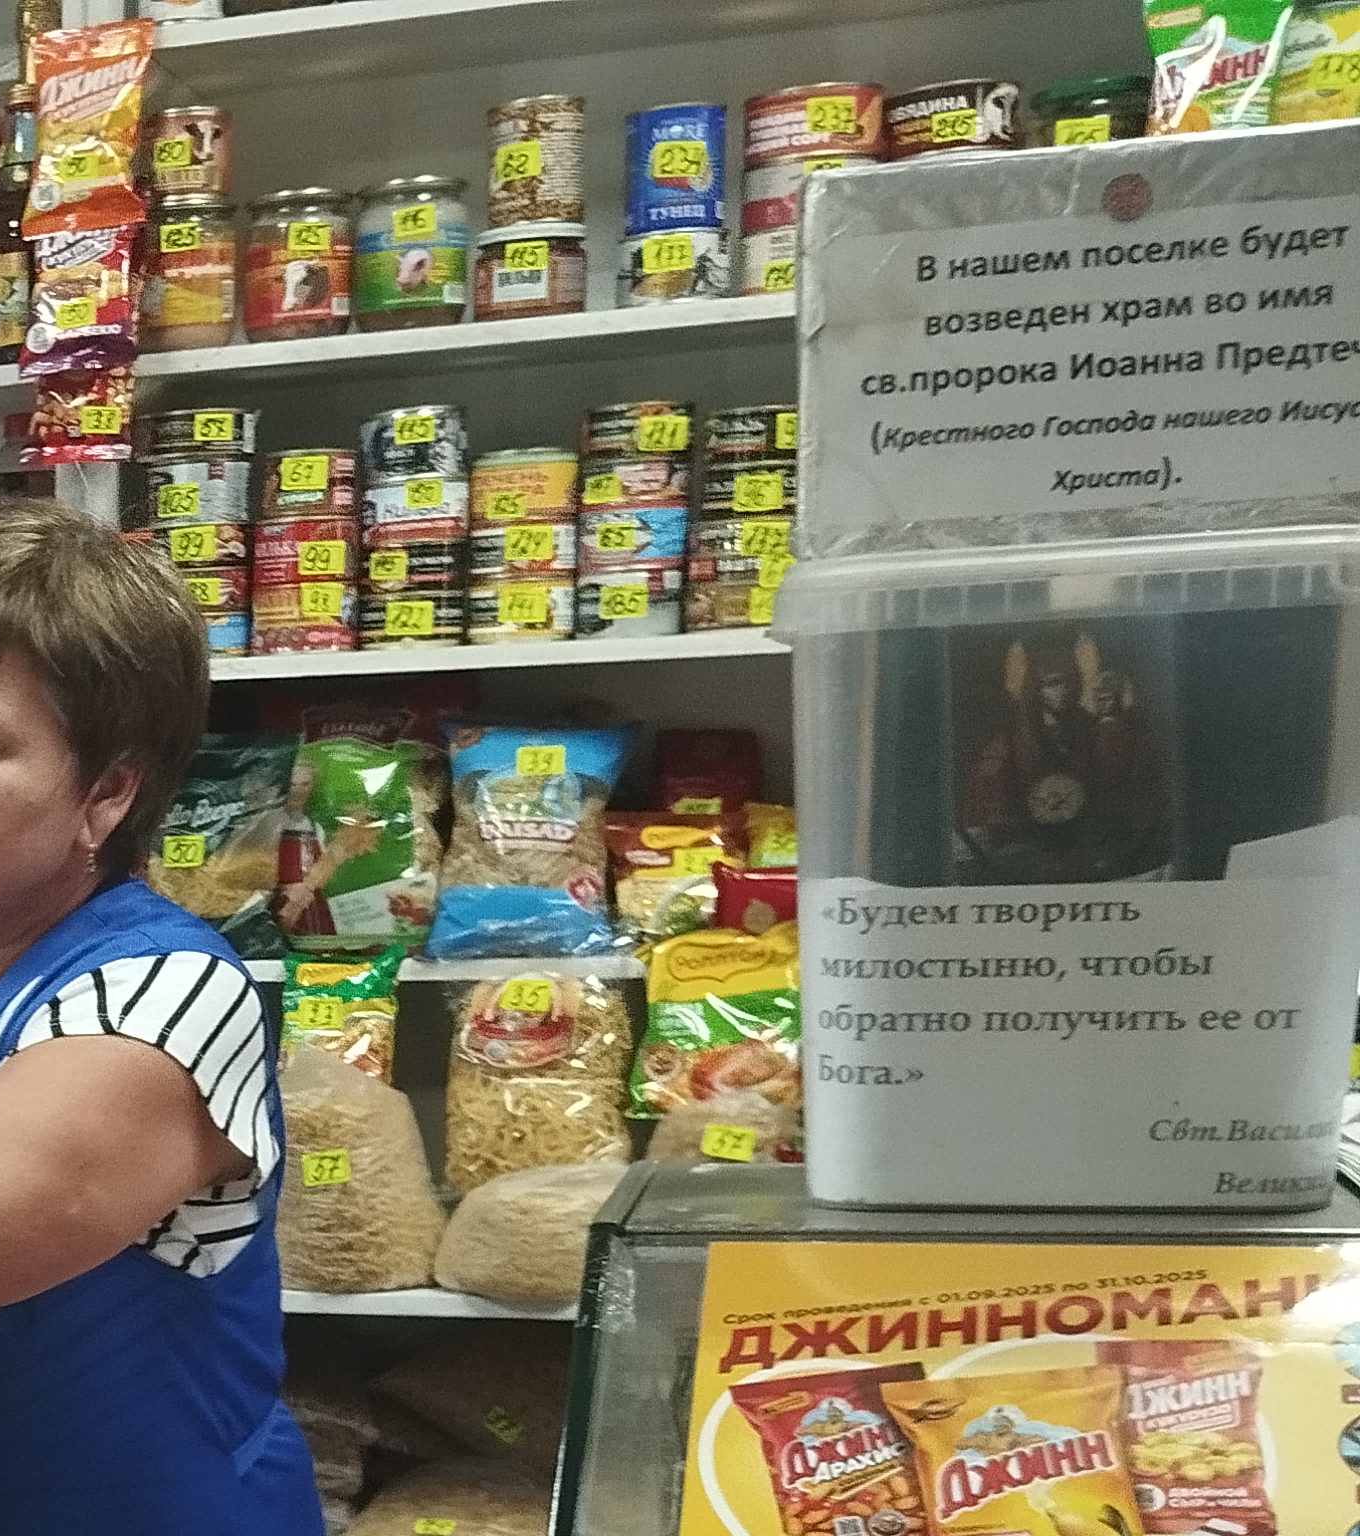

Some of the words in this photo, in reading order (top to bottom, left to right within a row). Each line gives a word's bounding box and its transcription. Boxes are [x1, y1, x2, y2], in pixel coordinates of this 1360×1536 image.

[917, 256, 937, 283] В
[947, 246, 1071, 281] нашем
[1081, 231, 1229, 270] поселке
[1240, 223, 1350, 262] будет
[926, 306, 1091, 337] возведен
[1101, 295, 1192, 332] храм
[1205, 288, 1245, 315] во
[1257, 283, 1335, 310] имя
[861, 360, 1058, 398] св.пророка
[1069, 346, 1203, 381] Иоанна
[871, 419, 1036, 456] (Крестного
[1042, 409, 1153, 440] Господа
[1162, 400, 1272, 431] нашего
[1049, 457, 1183, 493] Христа).
[822, 896, 960, 934] «Будем
[970, 900, 1141, 934] творить
[822, 954, 1068, 983] милостыню,
[1079, 947, 1215, 979] чтобы
[818, 1003, 972, 1040] обратно
[982, 1007, 1187, 1041] получить
[1198, 1008, 1243, 1031] ее
[1253, 1007, 1302, 1031] от
[718, 1272, 1320, 1374] ДЖИННОМАН
[721, 1311, 777, 1326] Срок
[782, 1297, 912, 1320] проведения
[1062, 1281, 1088, 1293] по
[1095, 1268, 1208, 1291] 31.10.2025
